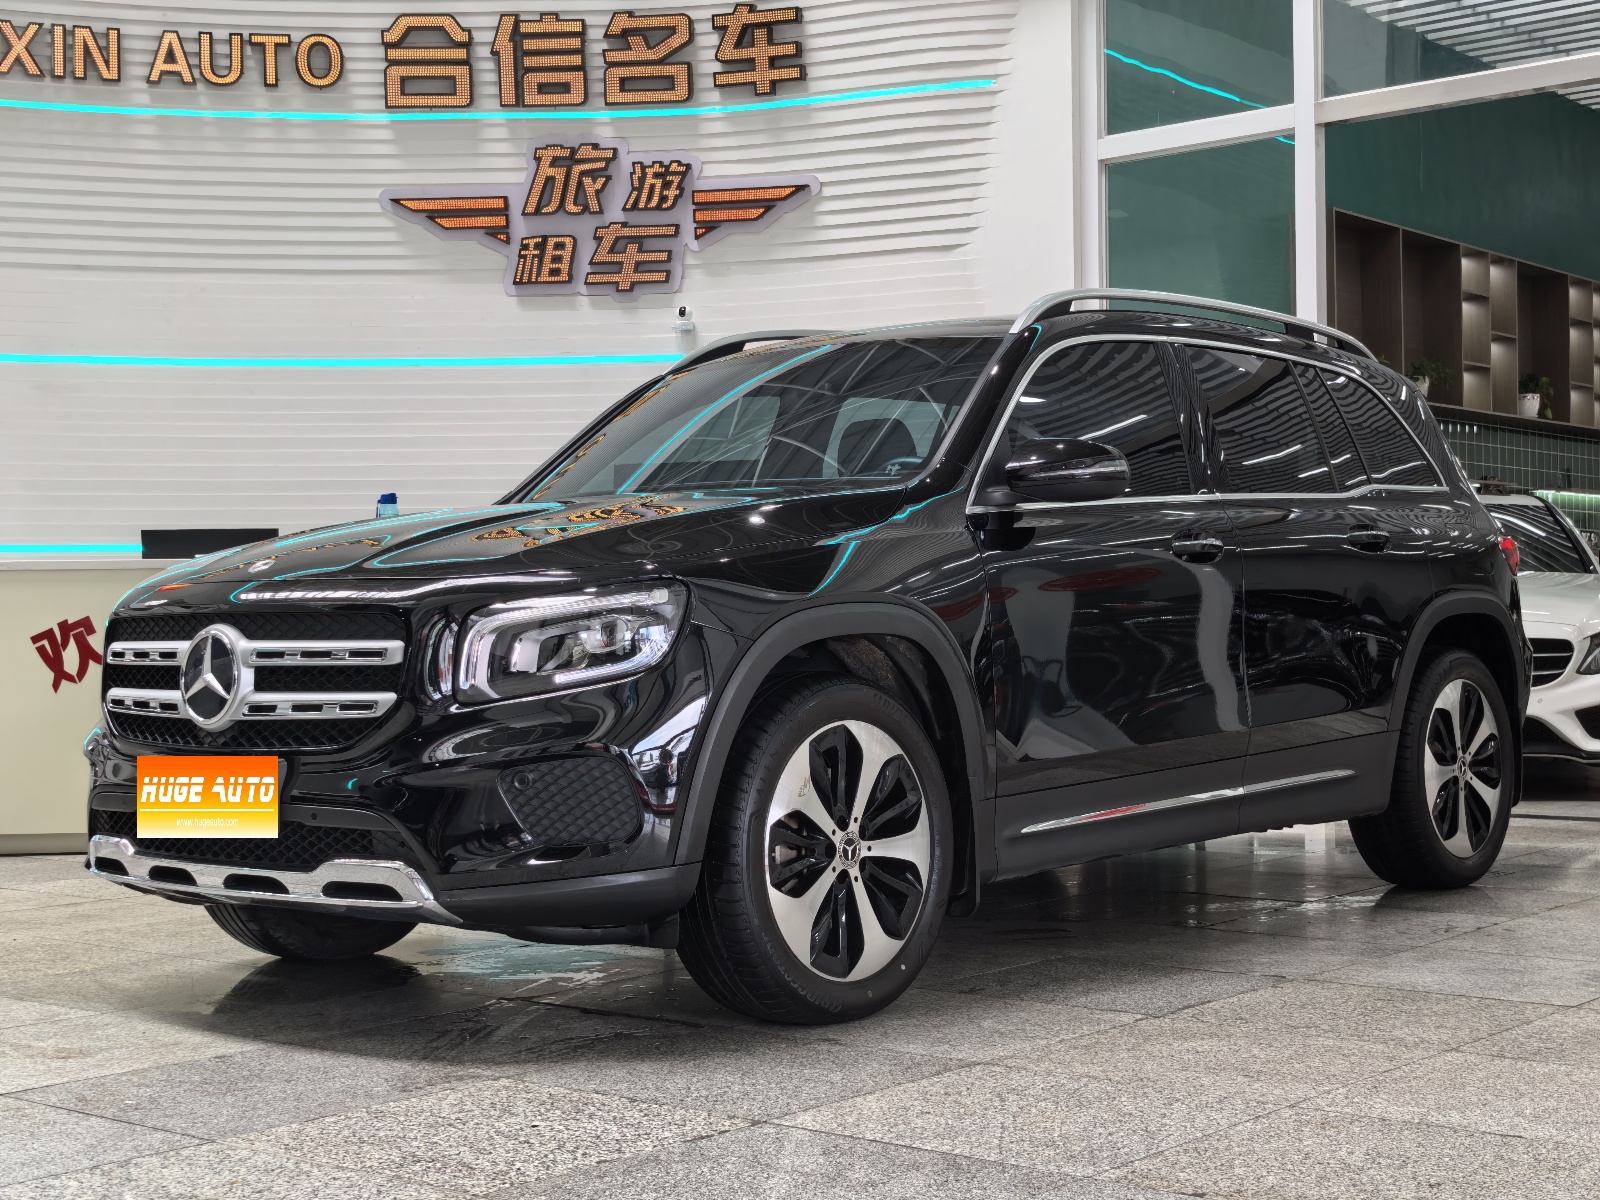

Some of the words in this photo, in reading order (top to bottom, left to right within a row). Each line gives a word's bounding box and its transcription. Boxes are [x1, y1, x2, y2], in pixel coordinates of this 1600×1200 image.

[146, 30, 344, 88] AUTO
[381, 4, 806, 109] 合信名车
[521, 143, 692, 217] 旅游
[512, 222, 681, 292] 租车
[29, 615, 103, 694] 欢
